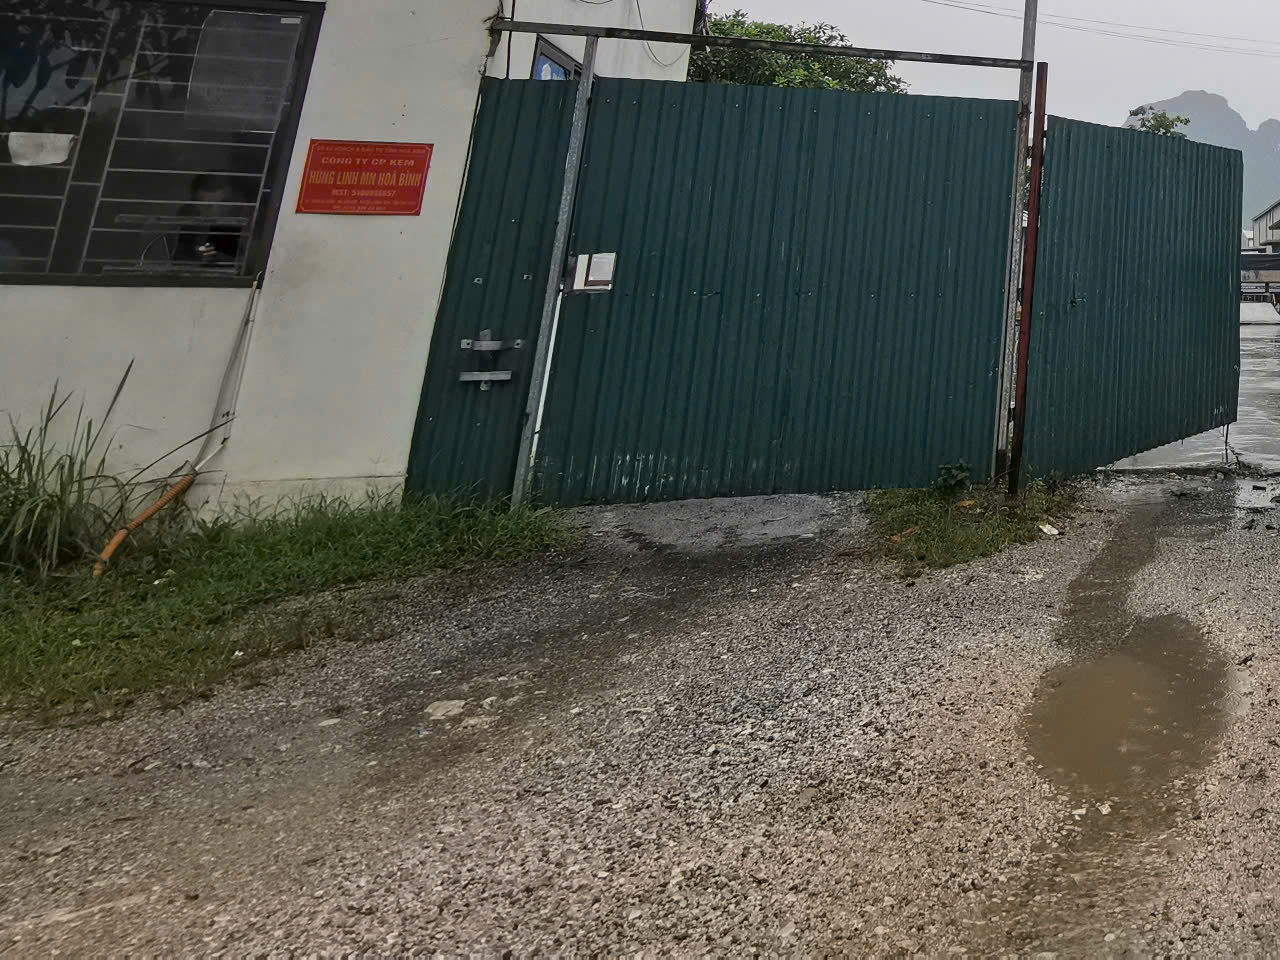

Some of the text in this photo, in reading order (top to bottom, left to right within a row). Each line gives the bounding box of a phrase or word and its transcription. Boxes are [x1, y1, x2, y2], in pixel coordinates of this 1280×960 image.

[321, 156, 352, 164] CÔNG
[336, 171, 359, 185] LINH
[398, 170, 422, 187] BÌNH
